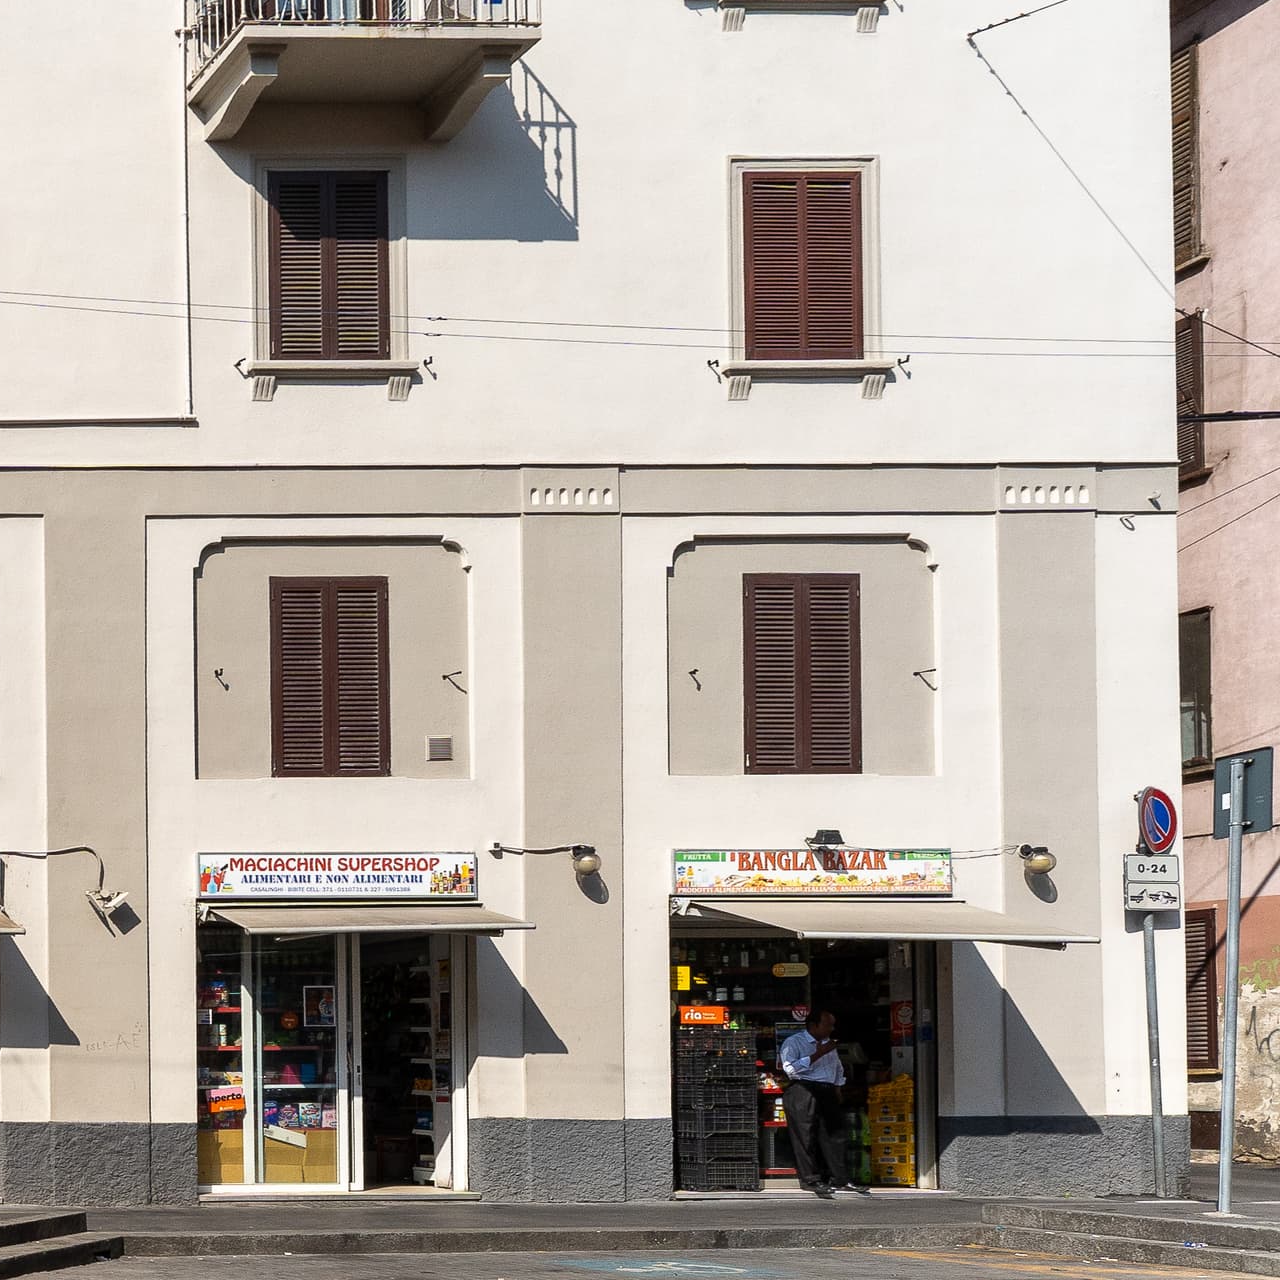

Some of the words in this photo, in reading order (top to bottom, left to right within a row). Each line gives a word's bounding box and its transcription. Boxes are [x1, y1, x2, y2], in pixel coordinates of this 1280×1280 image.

[229, 858, 332, 872] MACIACHINI
[338, 858, 439, 872] SUPERSHOP
[738, 851, 816, 871] BANGLA
[823, 851, 887, 871] BAZAR
[1138, 864, 1167, 874] 0-24
[241, 875, 311, 883] ALIMENTARI
[316, 875, 322, 883] E
[326, 875, 349, 883] NON
[353, 875, 423, 883] ALIMENTARI
[684, 1008, 702, 1020] ria
